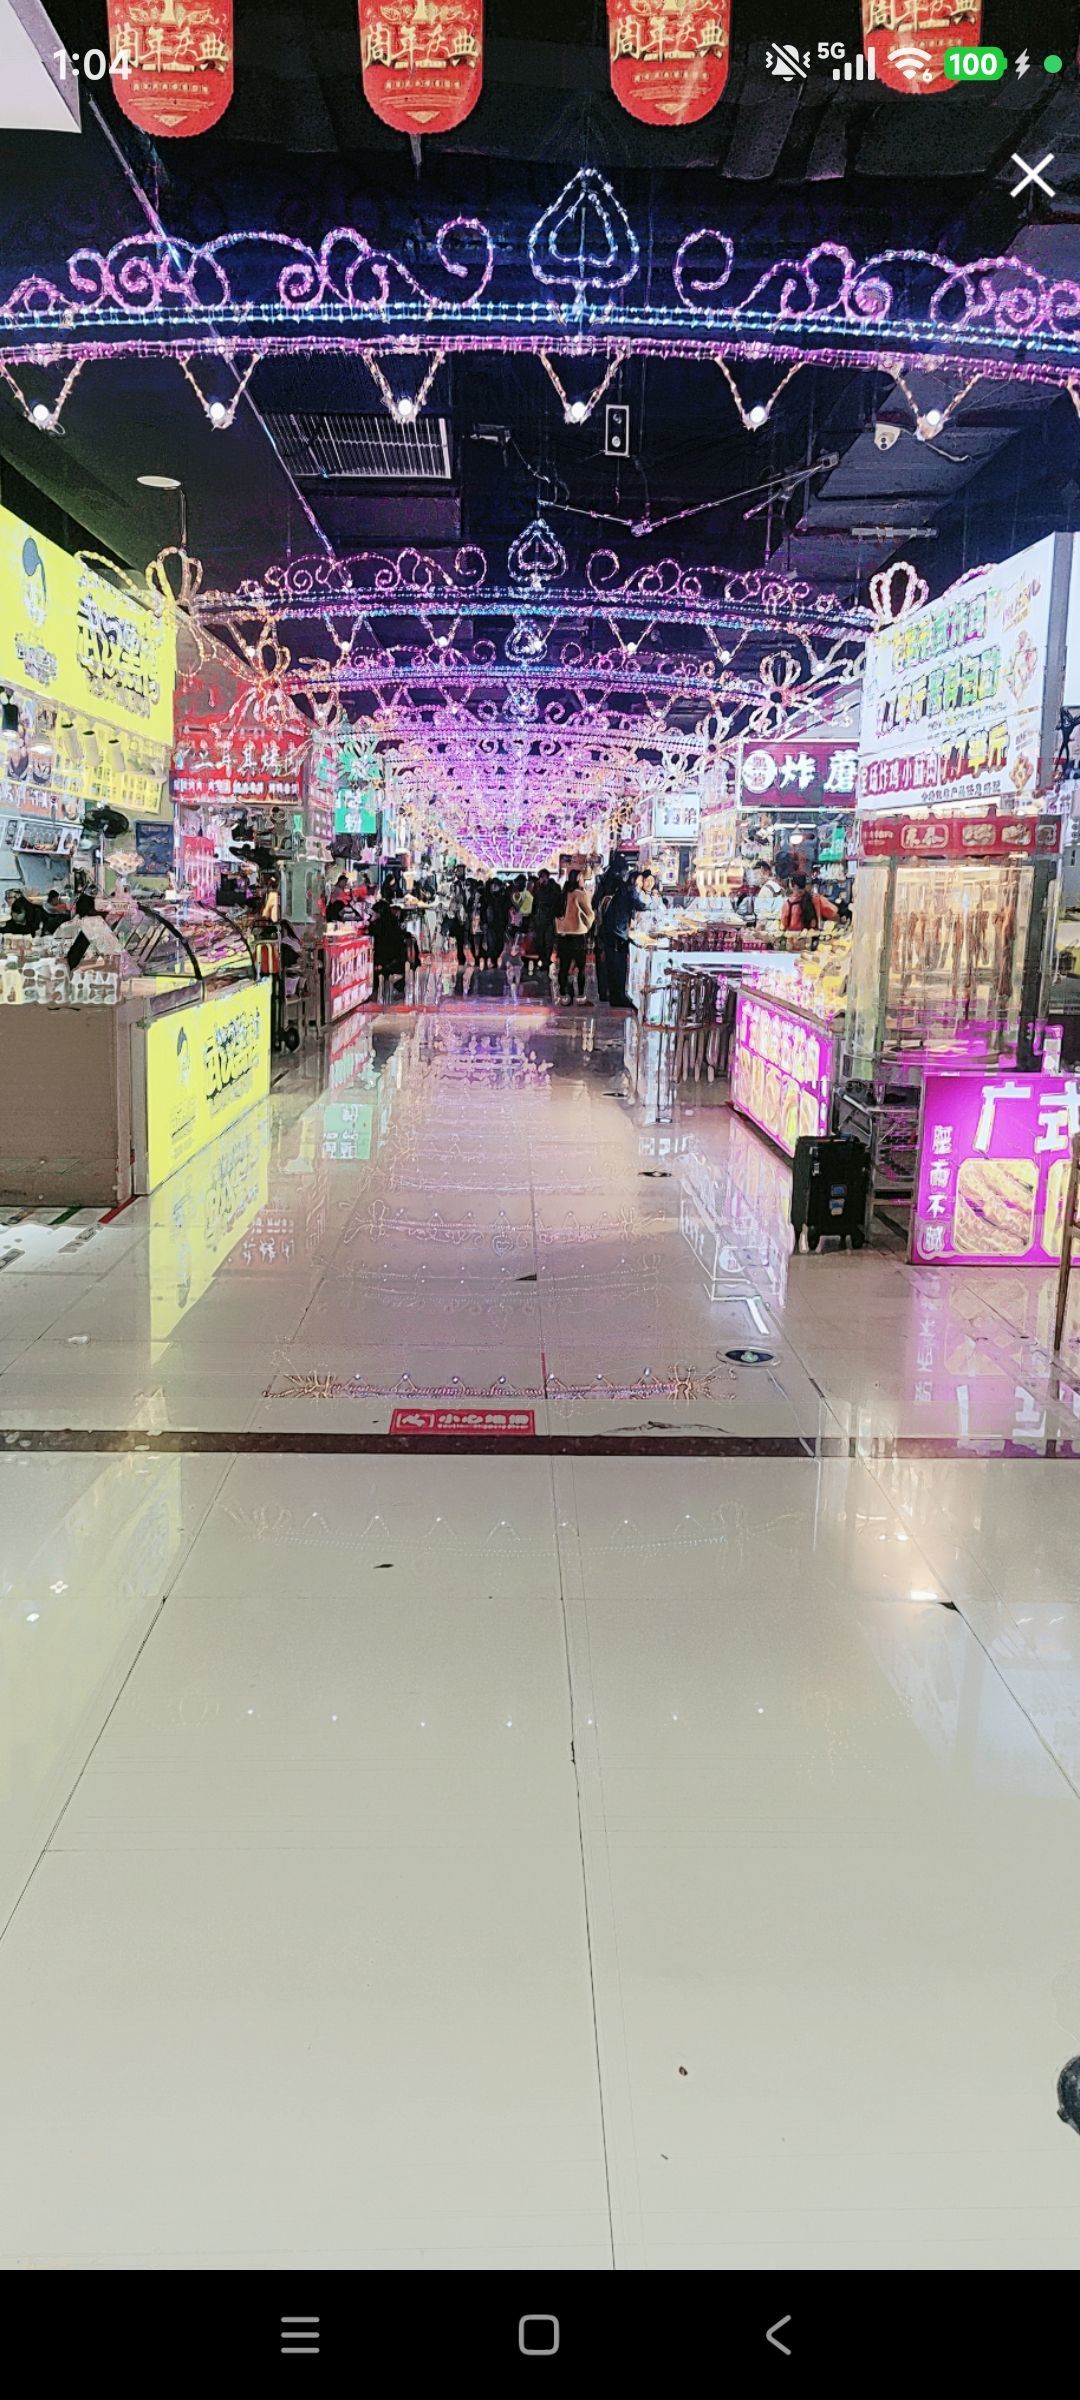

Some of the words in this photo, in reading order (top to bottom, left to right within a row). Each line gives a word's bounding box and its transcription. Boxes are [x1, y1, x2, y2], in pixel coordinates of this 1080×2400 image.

[364, 21, 479, 75] 周年庆典
[612, 14, 727, 63] 周年庆典
[973, 1080, 1080, 1154] 广式
